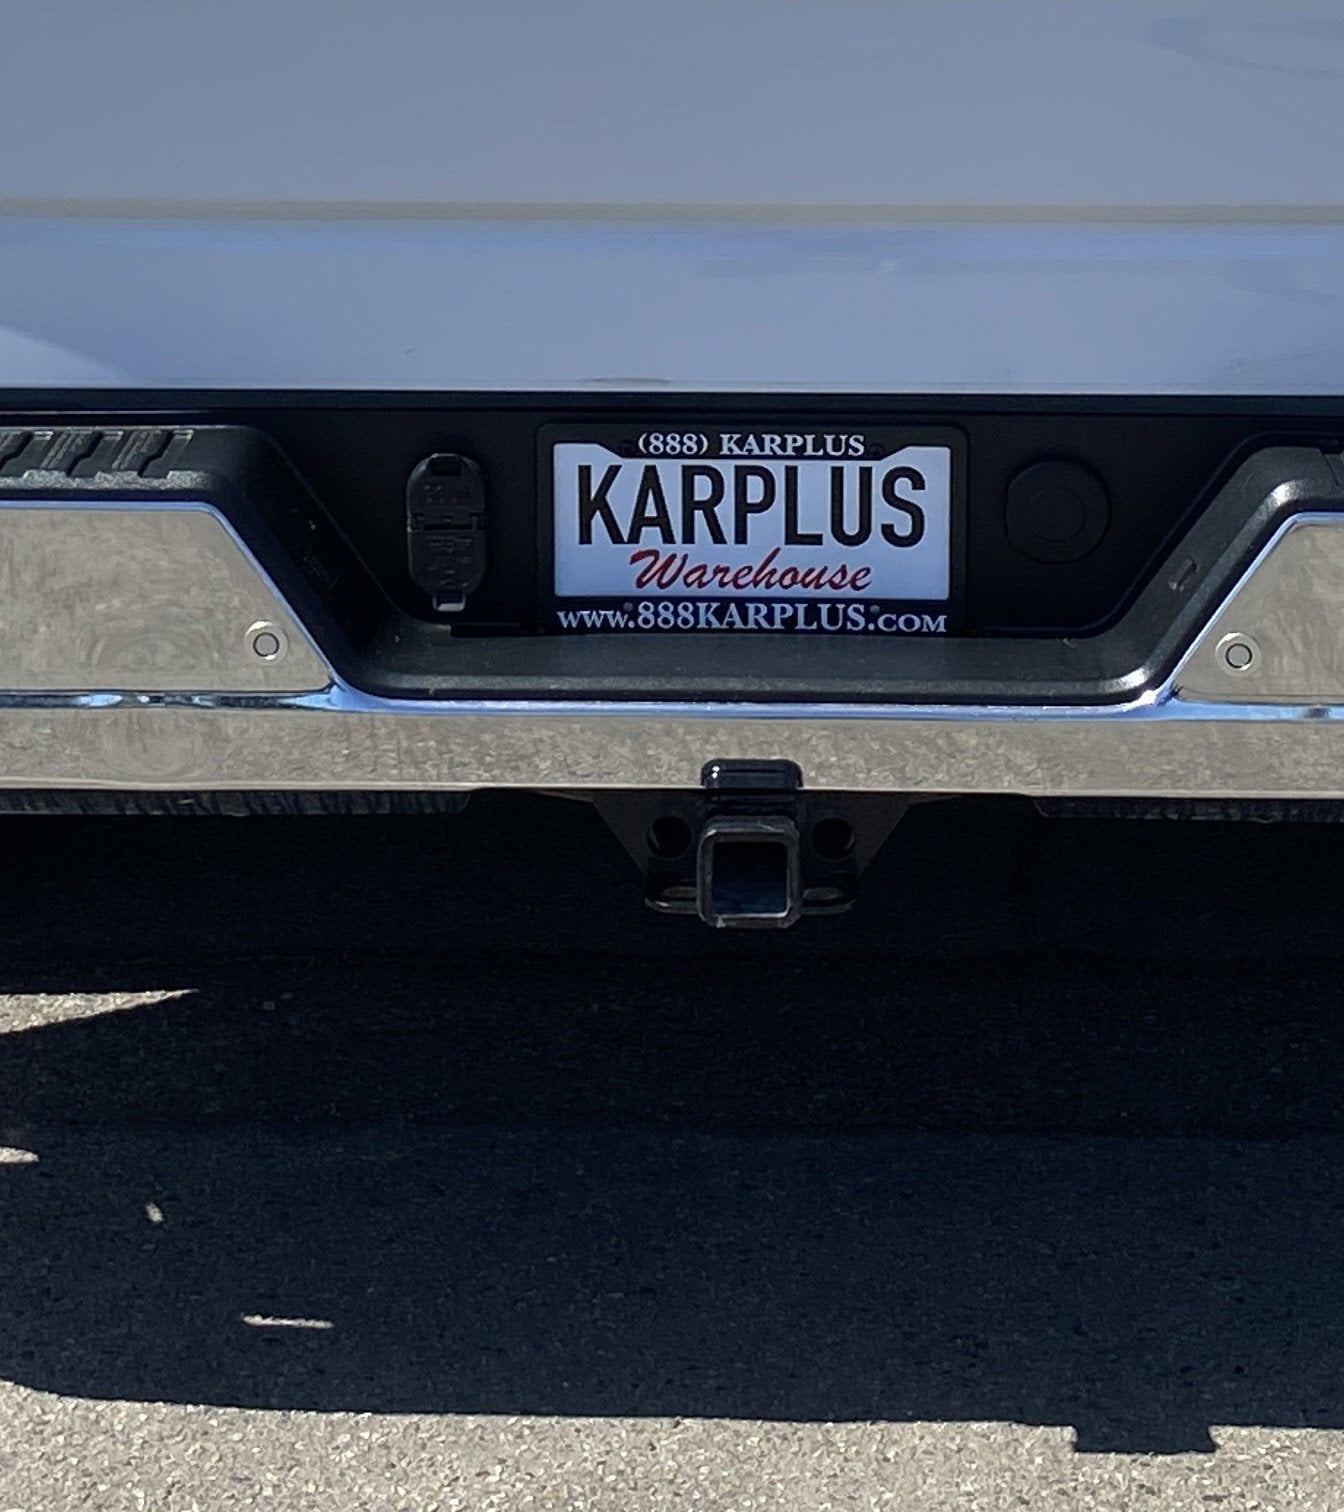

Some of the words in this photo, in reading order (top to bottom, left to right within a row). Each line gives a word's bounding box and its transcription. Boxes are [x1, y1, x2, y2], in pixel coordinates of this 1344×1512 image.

[637, 432, 709, 456] (888)
[720, 433, 865, 457] KARPLUS
[577, 464, 927, 548] KARPLUS
[629, 547, 873, 592] Warehouse
